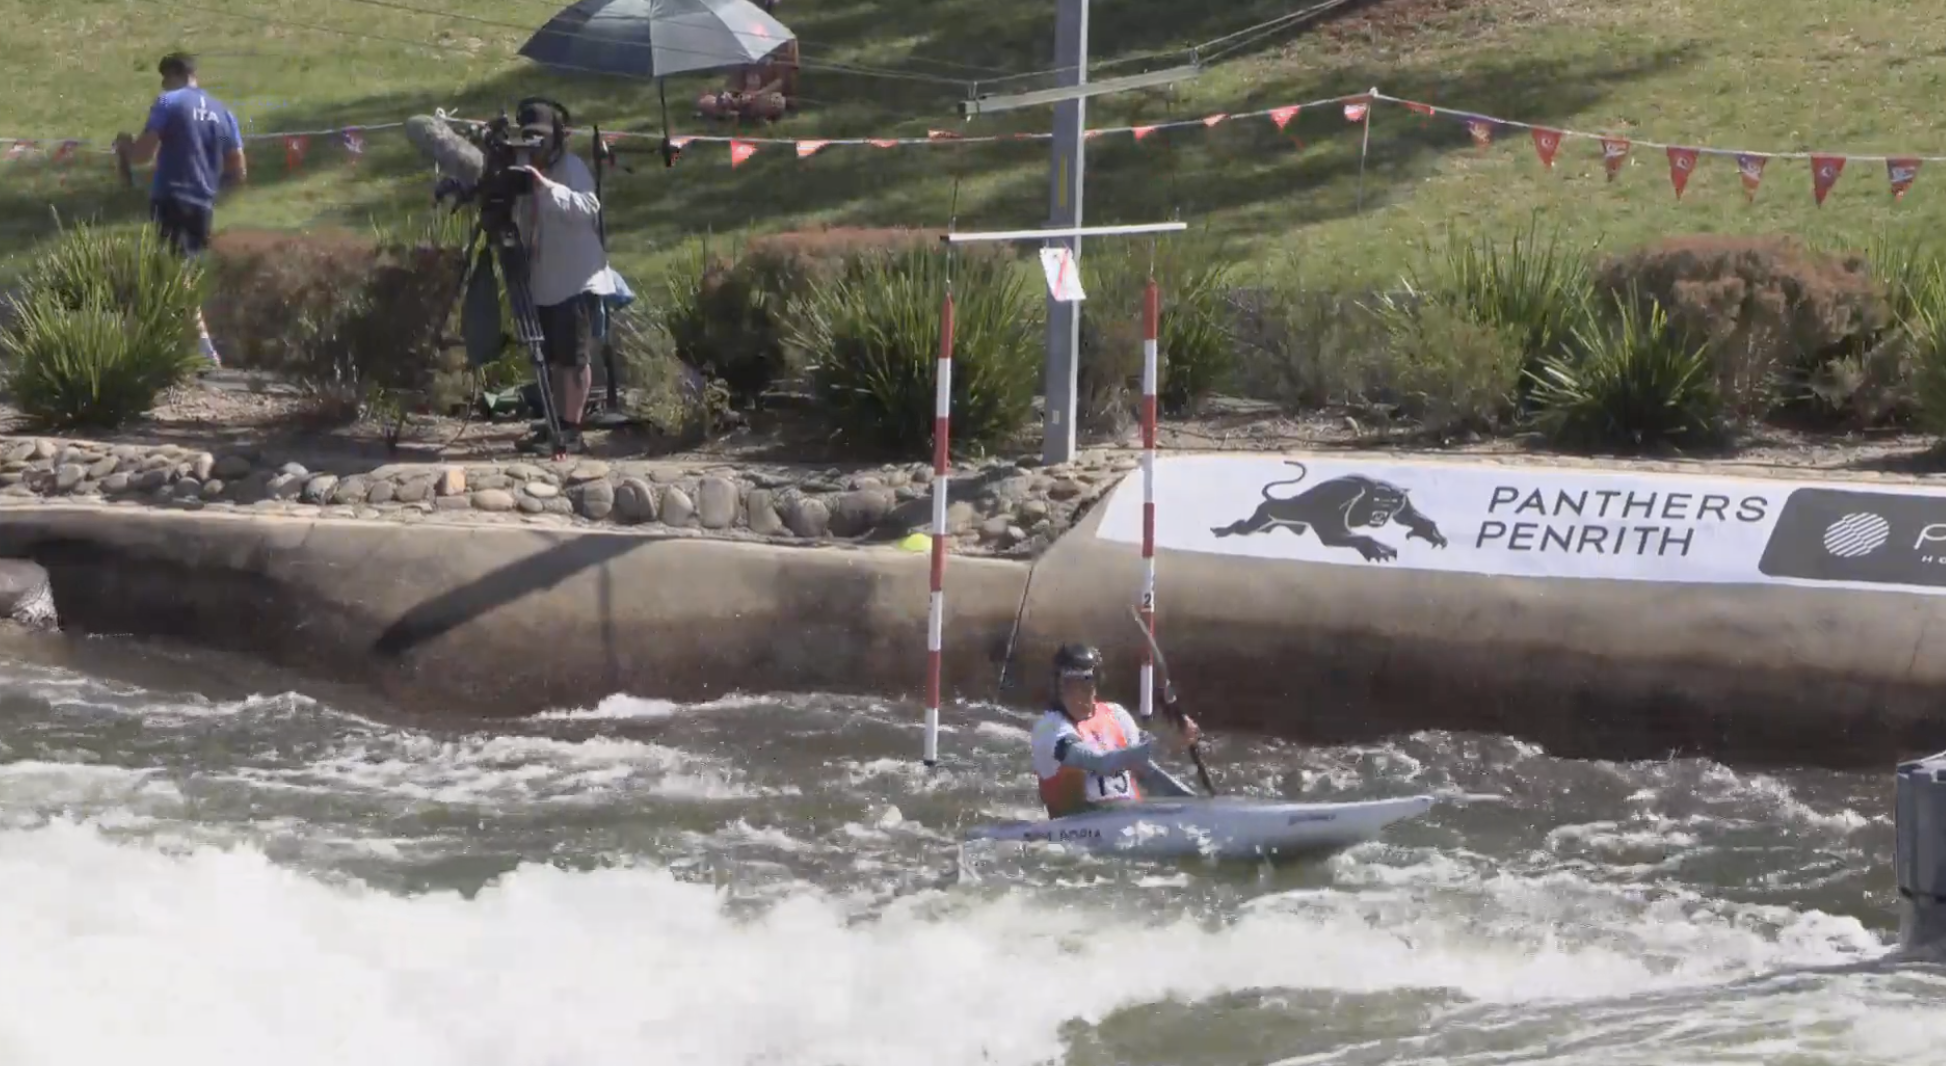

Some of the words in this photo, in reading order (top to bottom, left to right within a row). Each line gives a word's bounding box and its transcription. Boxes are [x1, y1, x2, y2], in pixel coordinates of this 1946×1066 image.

[193, 106, 220, 123] ITA
[1488, 486, 1768, 522] PANTHERS
[1475, 521, 1694, 556] PENRITH
